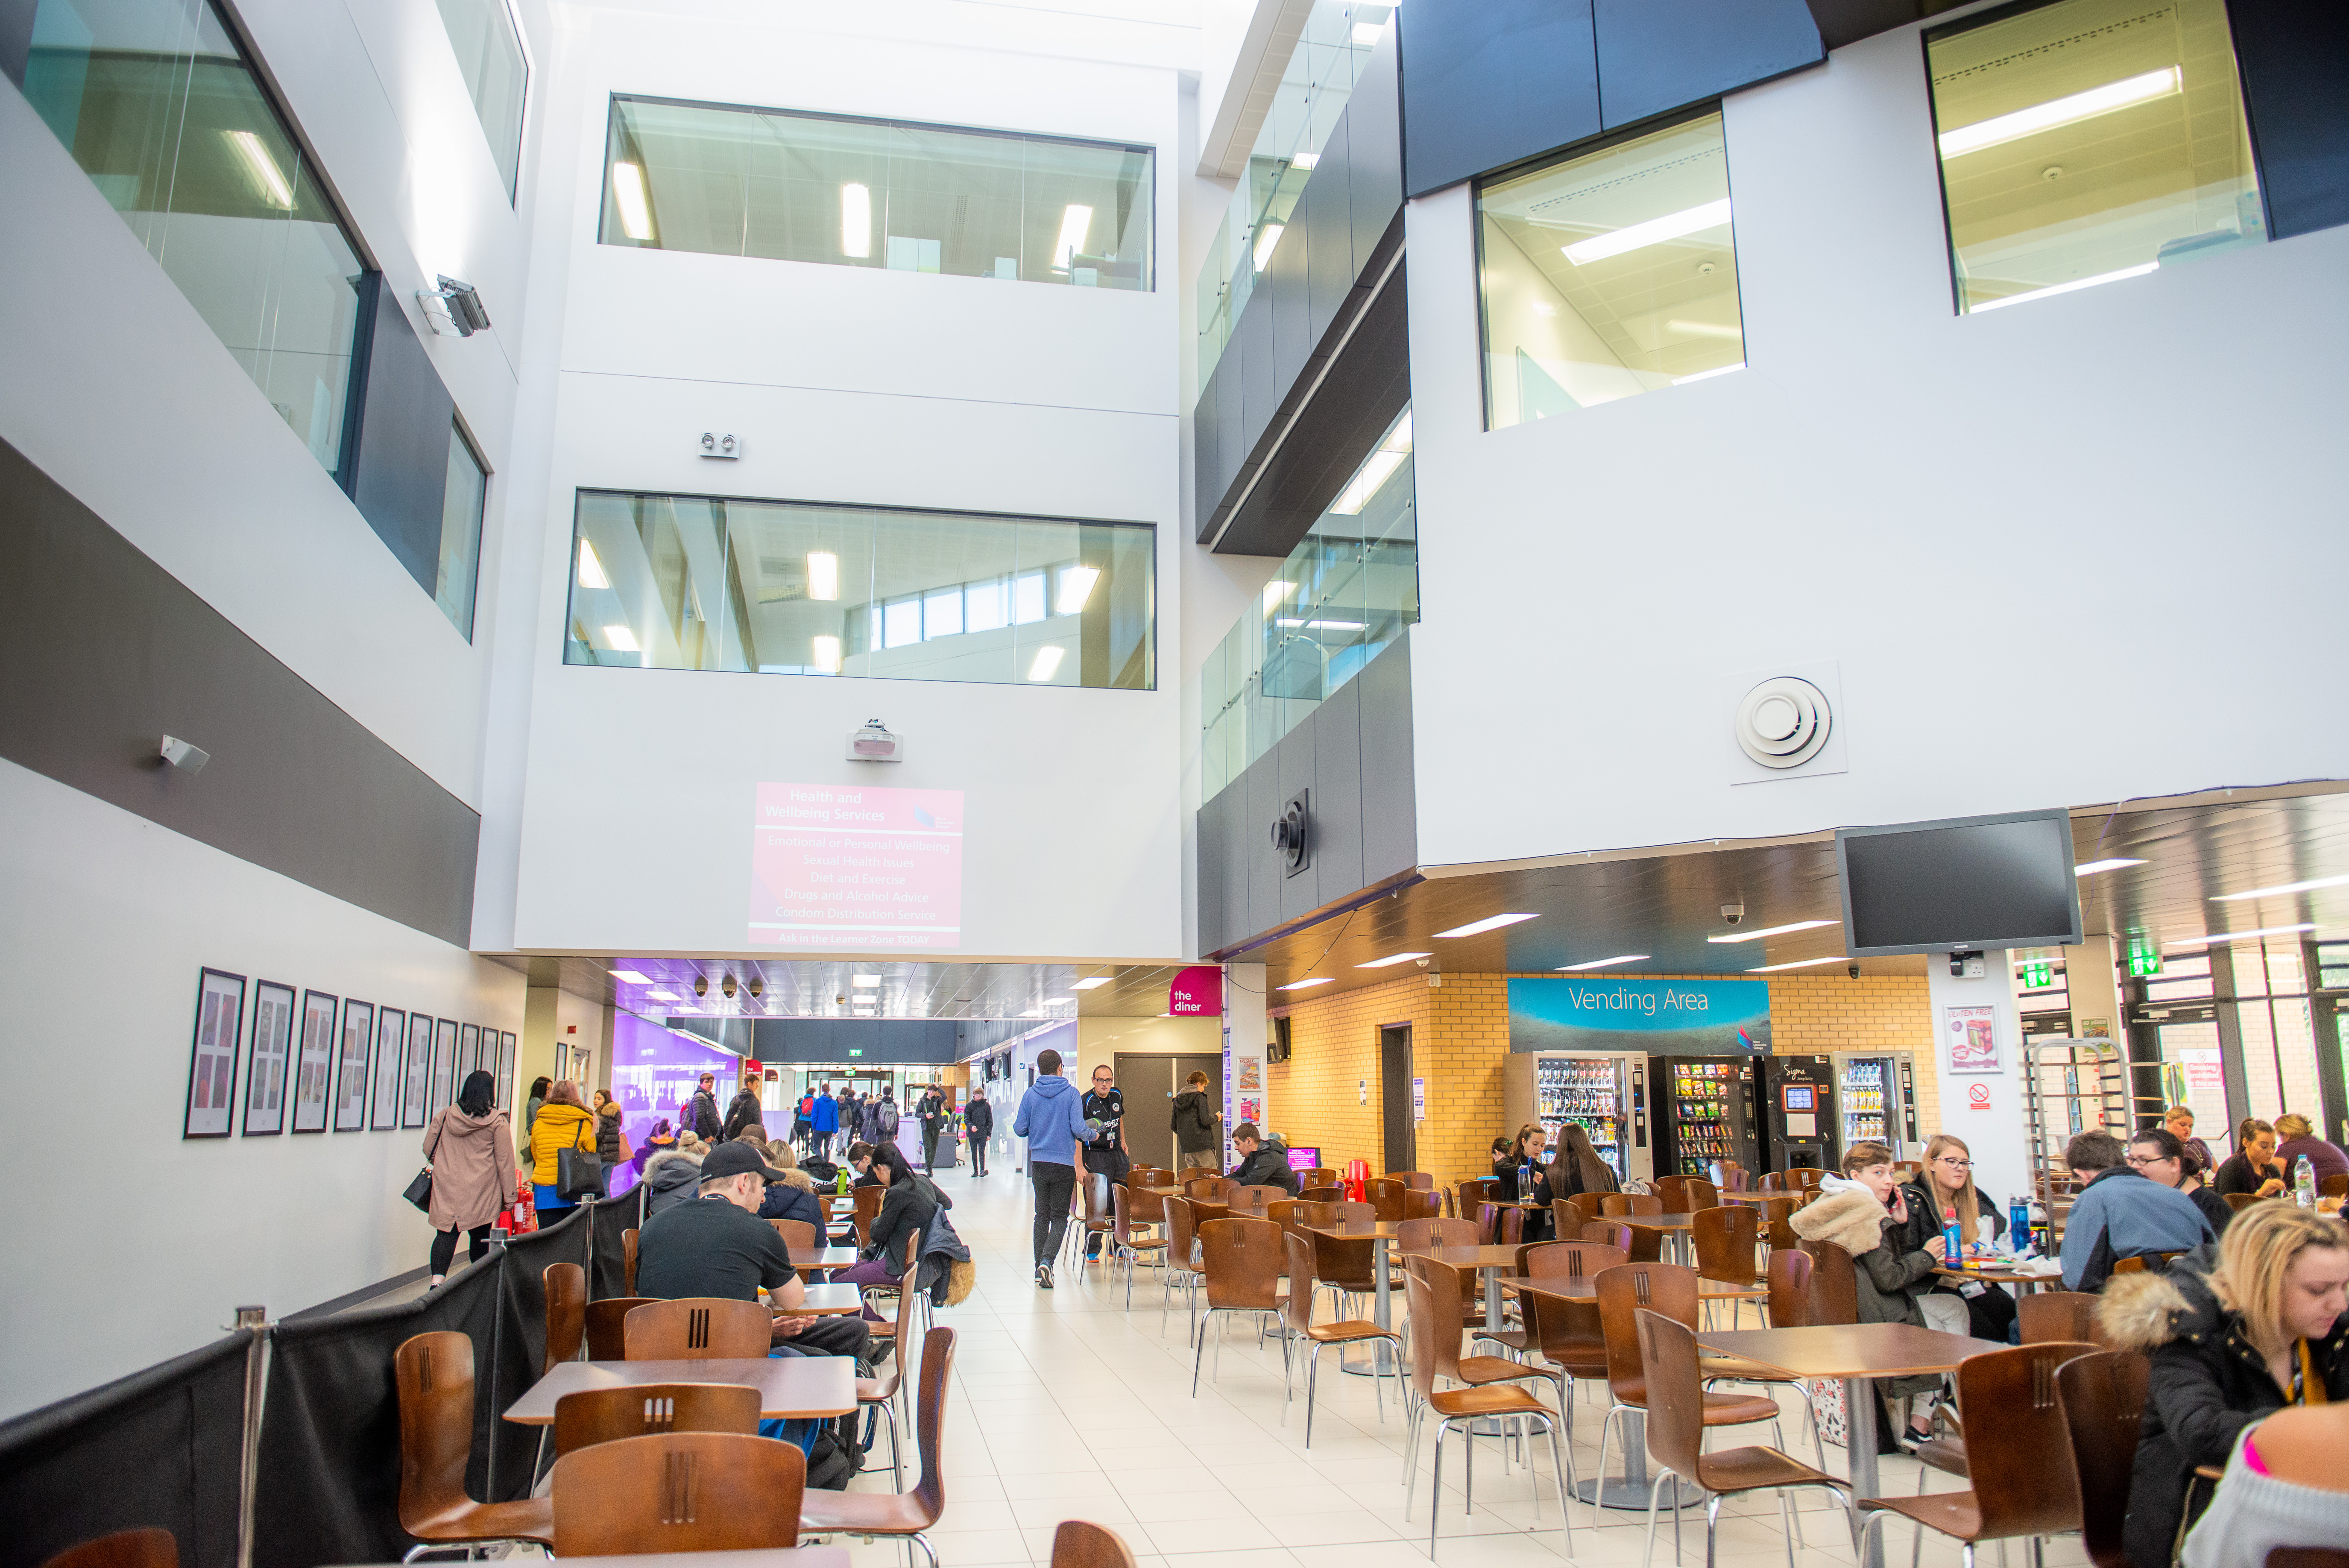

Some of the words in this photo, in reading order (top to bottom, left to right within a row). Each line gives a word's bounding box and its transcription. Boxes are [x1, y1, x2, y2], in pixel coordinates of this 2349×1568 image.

[791, 790, 834, 803] Health
[838, 792, 862, 804] and
[765, 805, 830, 822] Wellbeing
[835, 808, 885, 821] Services
[768, 835, 826, 847] Emotional
[845, 838, 891, 850] Personal
[894, 840, 950, 854] Wellbeing
[804, 854, 840, 865] Sexual
[844, 856, 880, 867] Health
[884, 857, 915, 868] Issues
[811, 872, 835, 883] Diet
[838, 873, 859, 884] and
[863, 873, 906, 885] Exercise
[785, 888, 818, 902] Drugs
[821, 890, 843, 900] and
[846, 890, 889, 902] Alcohol
[892, 891, 930, 903] Advice
[776, 906, 825, 918] Condom
[828, 908, 895, 920] Distribution
[898, 909, 937, 920] Service
[779, 933, 797, 943] Ask
[800, 933, 808, 943] in
[811, 934, 828, 943] the
[831, 934, 869, 944] Learner
[870, 935, 895, 944] Zone
[897, 935, 930, 944] TODAY
[1174, 990, 1192, 1000] the
[1569, 987, 1656, 1016] Vending
[1663, 988, 1708, 1011] Area
[1174, 1001, 1201, 1011] diner
[1784, 1064, 1806, 1080] Sigma
